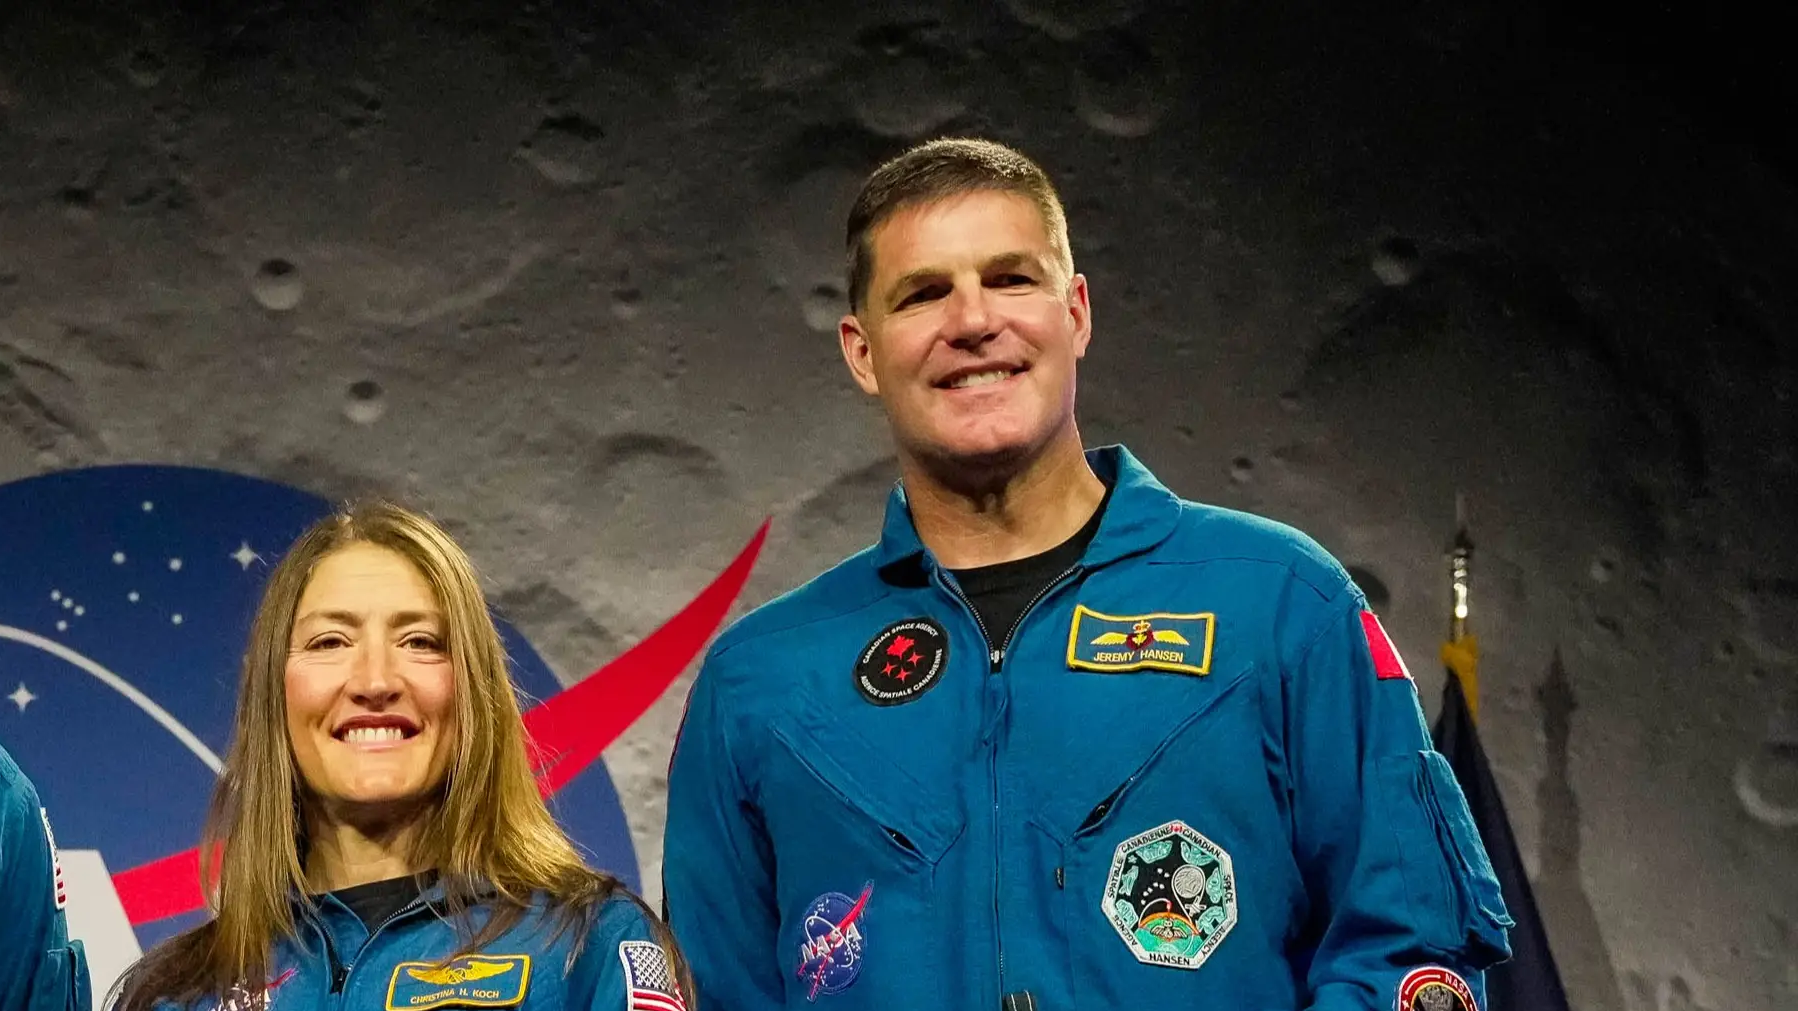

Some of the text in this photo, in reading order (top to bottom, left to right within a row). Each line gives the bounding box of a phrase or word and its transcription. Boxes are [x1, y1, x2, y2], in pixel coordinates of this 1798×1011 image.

[862, 622, 939, 664] CANADIAN SPACE AGENCY
[1093, 649, 1184, 663] JEREMY HANSEN
[879, 688, 913, 699] SPATIALE
[1108, 826, 1172, 946] AGENCE SPATIALE CANADIENNE
[1182, 828, 1233, 958] CANADIAN SPACE AGENCY
[801, 922, 863, 963] NASA
[1149, 954, 1190, 966] HANSEN
[410, 988, 455, 1004] CHRISTINA
[472, 989, 500, 999] KOCH
[1445, 973, 1469, 1000] NASA
